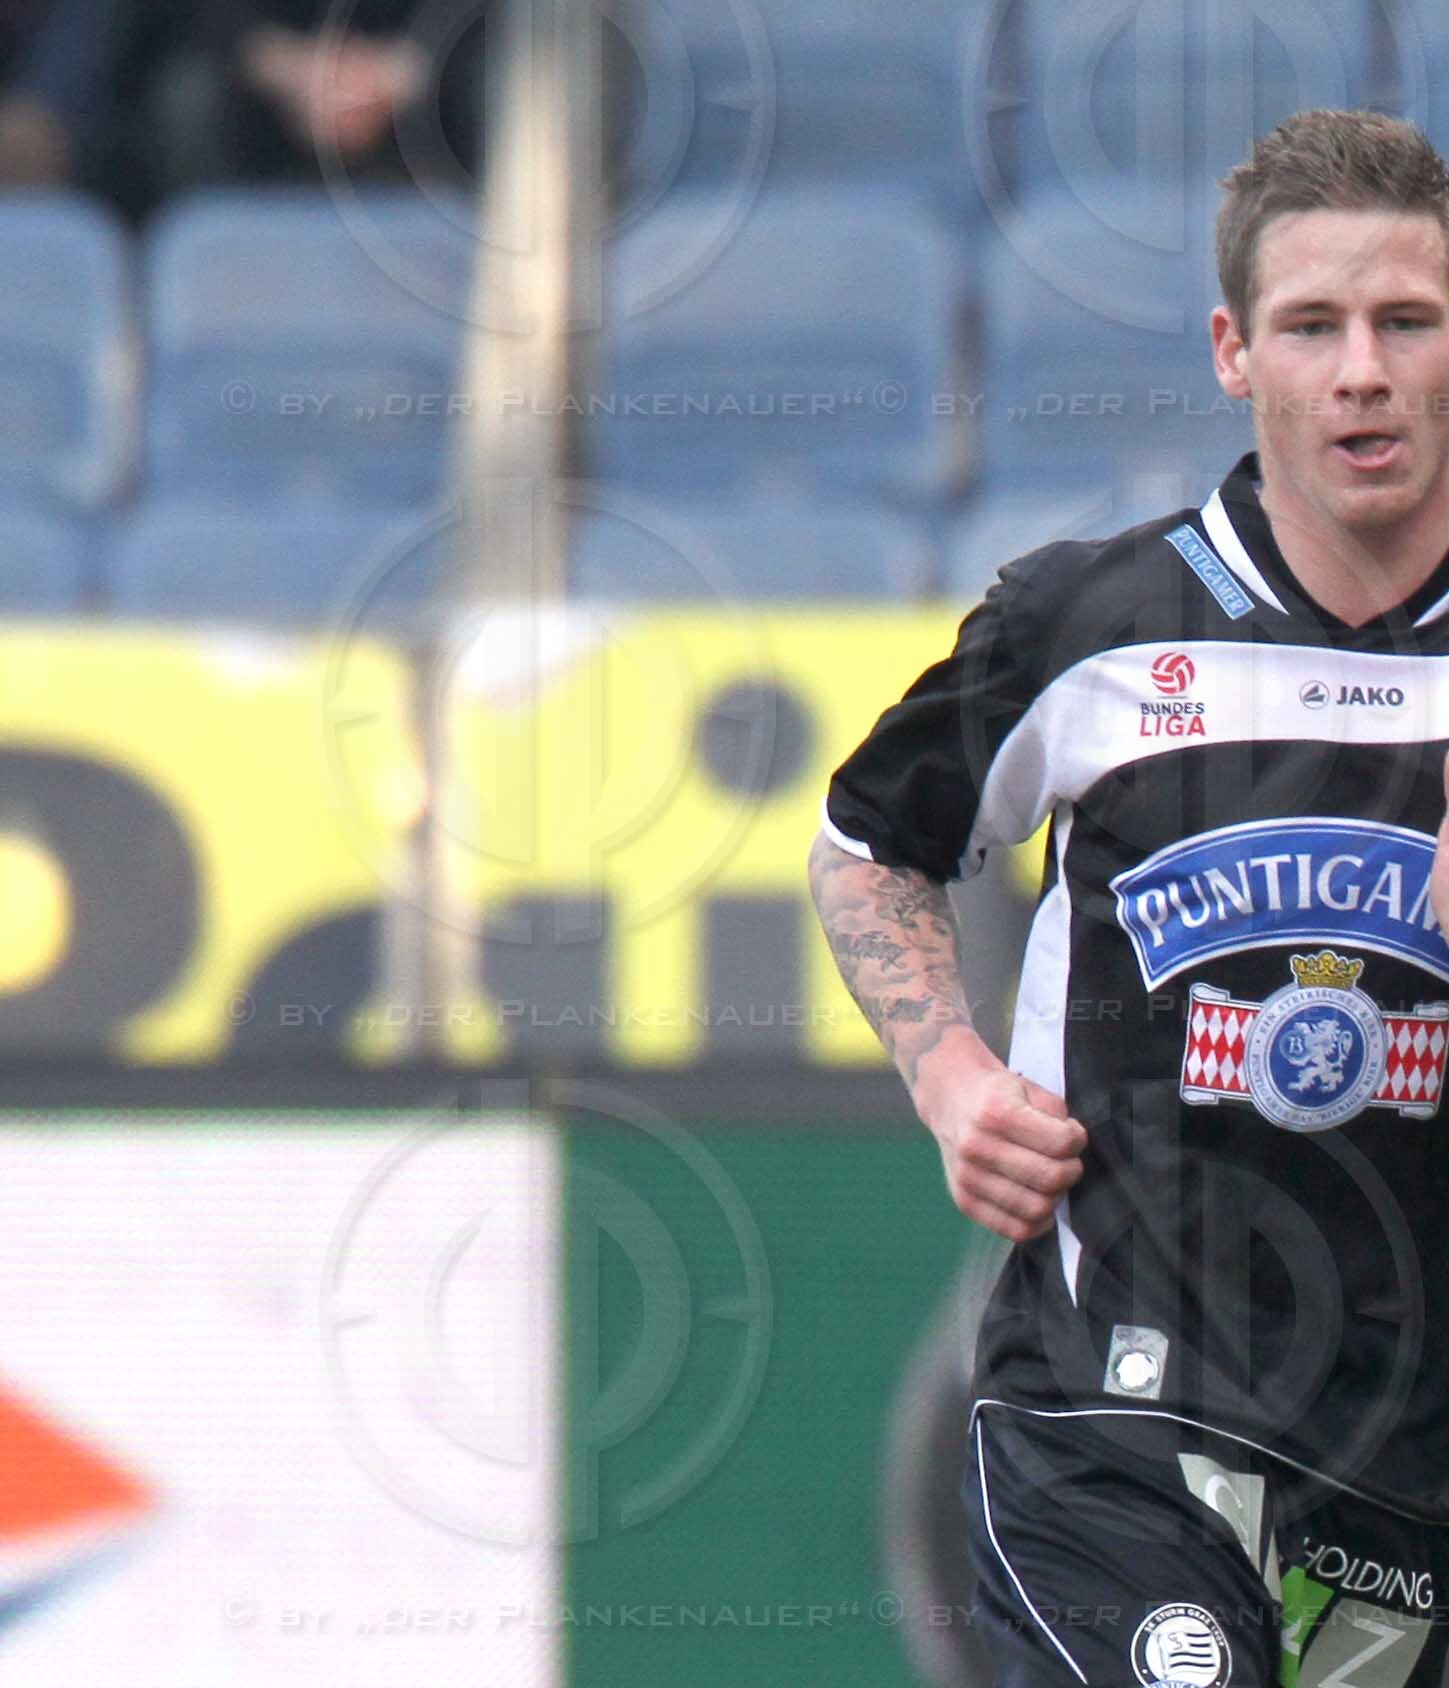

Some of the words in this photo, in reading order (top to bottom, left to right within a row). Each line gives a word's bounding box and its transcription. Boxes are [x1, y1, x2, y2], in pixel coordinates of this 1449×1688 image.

[1335, 685, 1405, 707] JAKO
[1141, 702, 1205, 716] BUNDES
[1139, 715, 1207, 737] LIGA
